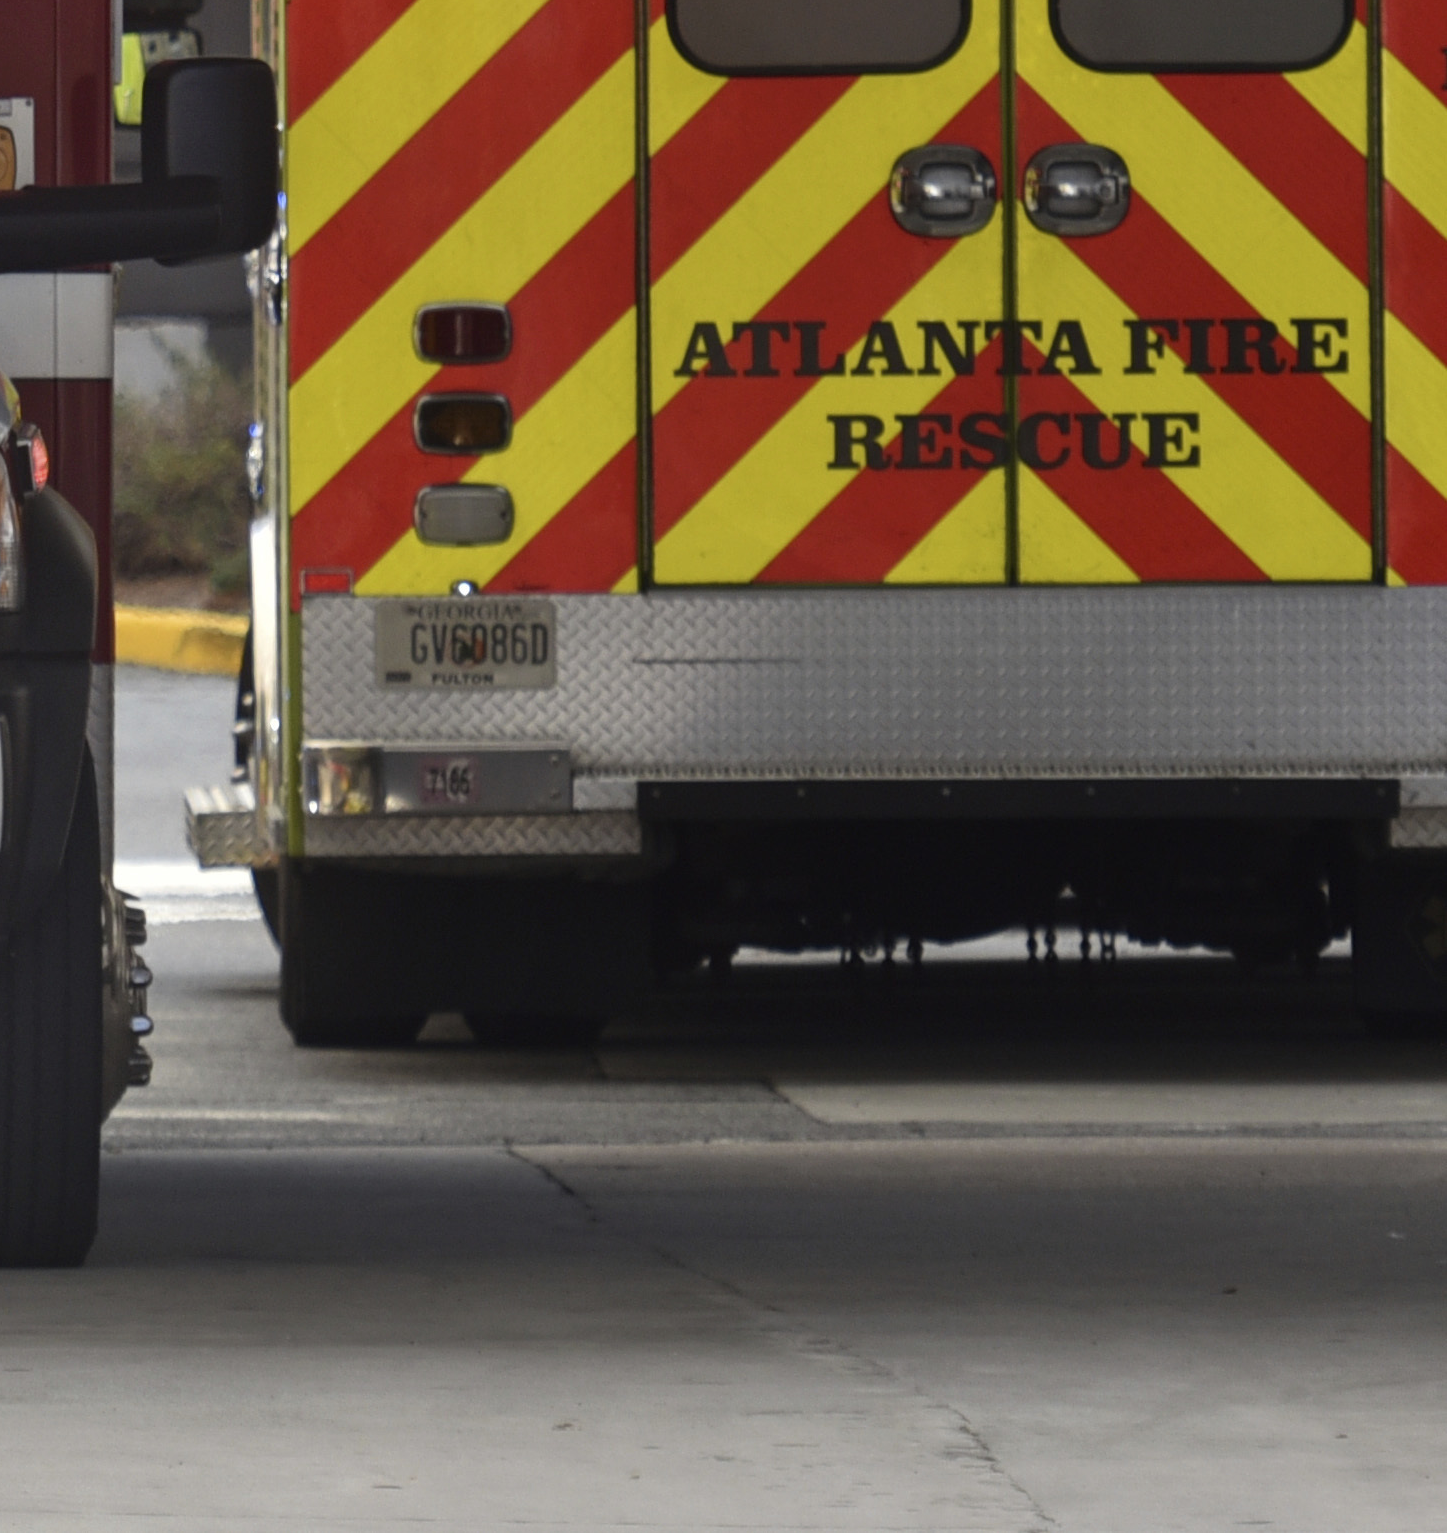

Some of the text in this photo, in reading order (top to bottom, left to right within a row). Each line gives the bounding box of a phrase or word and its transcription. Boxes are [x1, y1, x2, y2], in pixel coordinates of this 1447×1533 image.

[674, 318, 1349, 378] ATLANTA FIRE
[825, 411, 1201, 471] RESCUE
[418, 603, 513, 620] GEORGIA
[411, 623, 549, 665] GV6086D
[431, 673, 494, 685] FULTON
